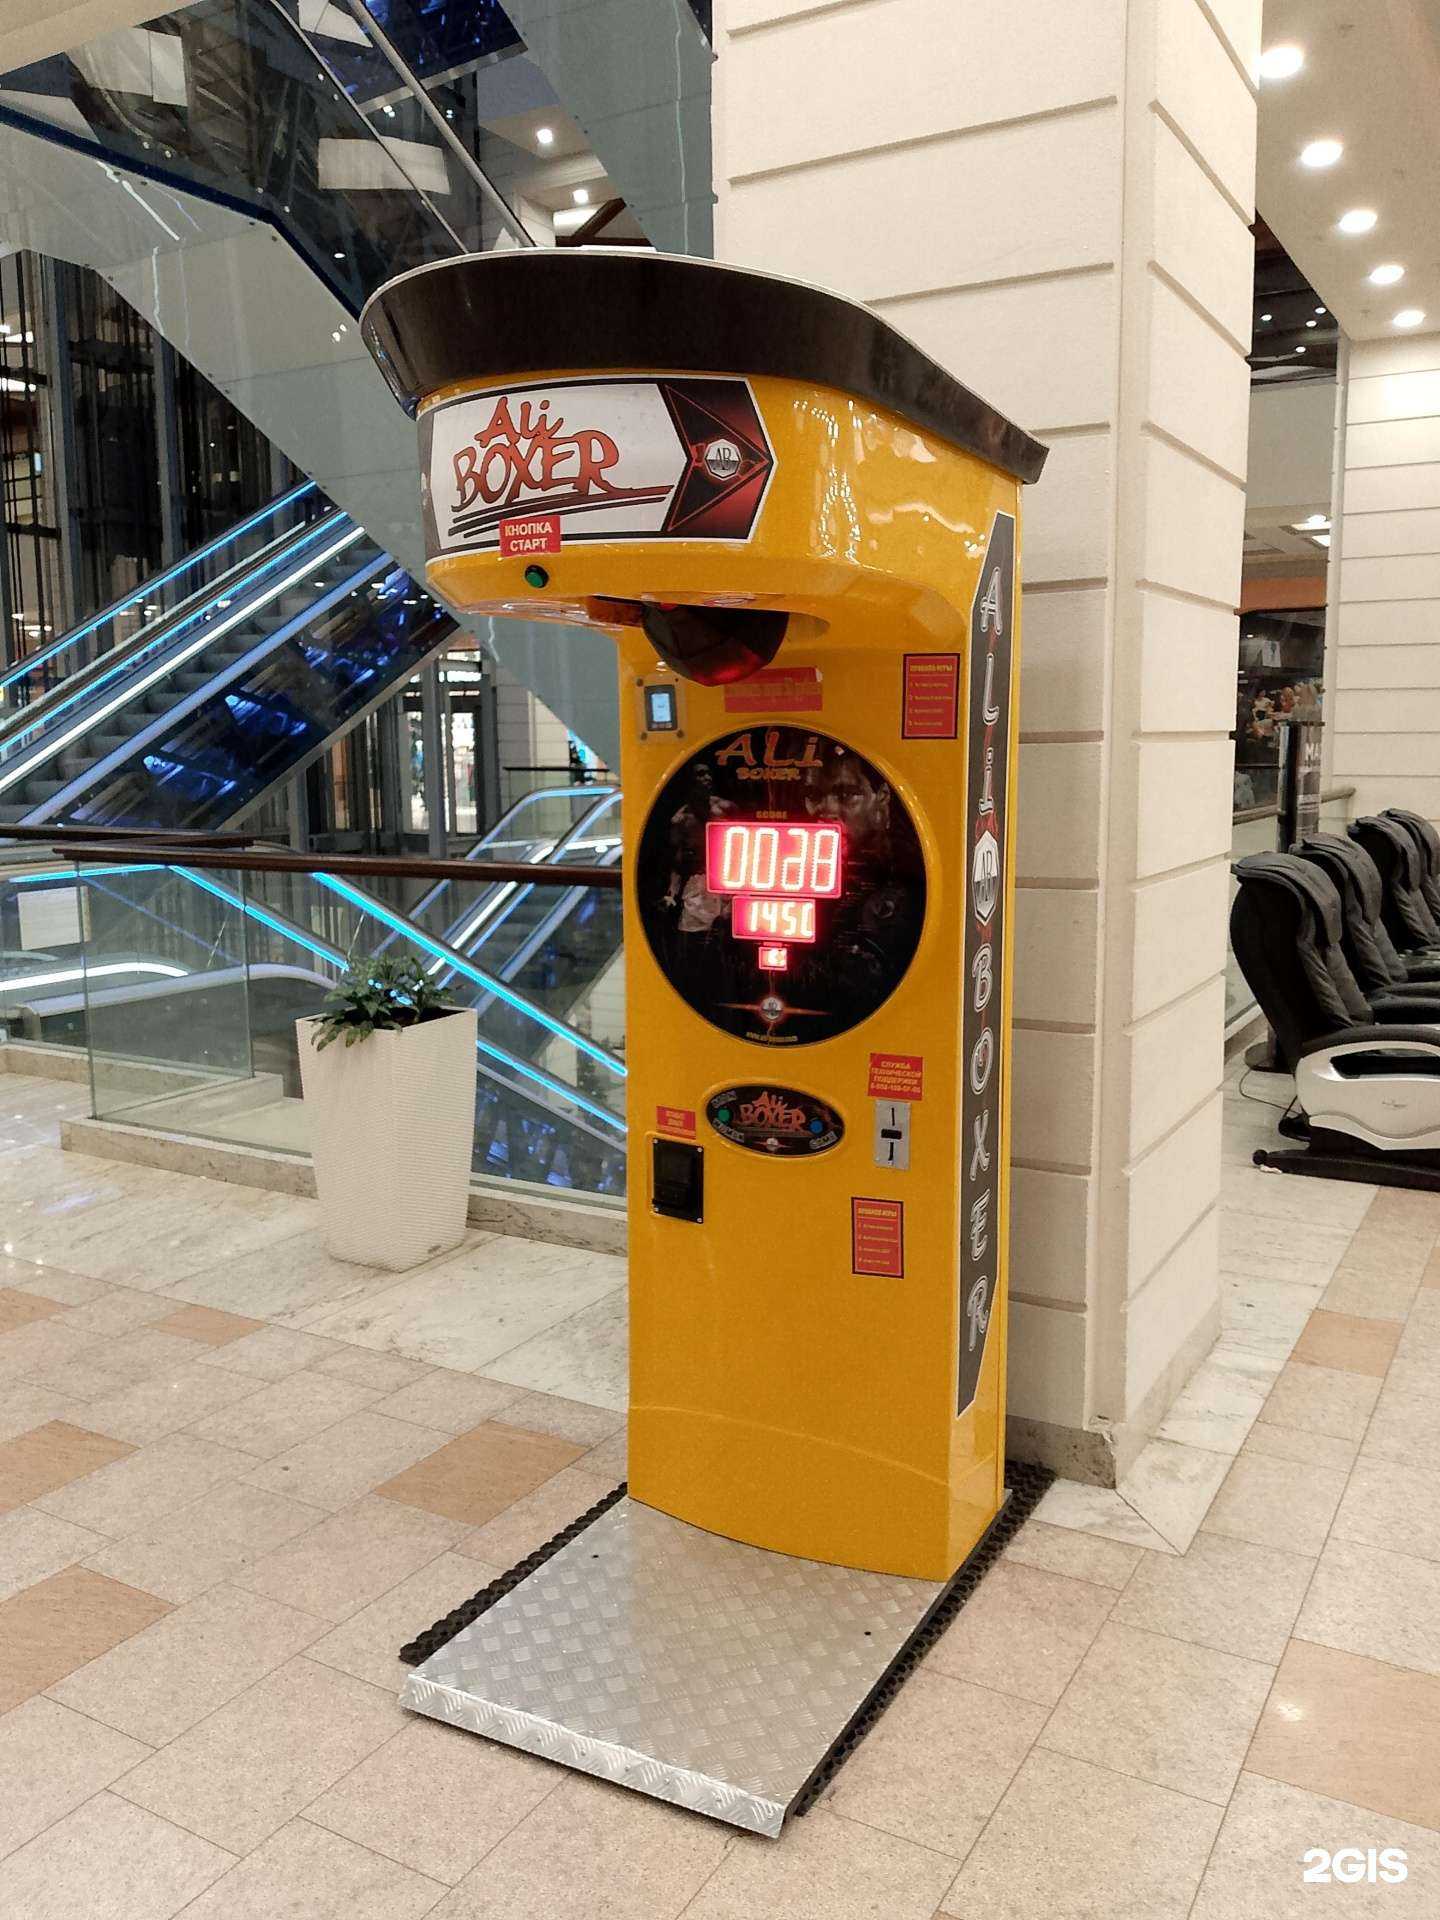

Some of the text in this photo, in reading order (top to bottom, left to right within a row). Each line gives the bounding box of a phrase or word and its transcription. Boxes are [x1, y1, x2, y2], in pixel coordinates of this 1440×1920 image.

[474, 396, 564, 447] Ali
[451, 429, 630, 512] BOXER
[504, 520, 553, 537] КНОПКА
[509, 537, 548, 552] СТАРТ
